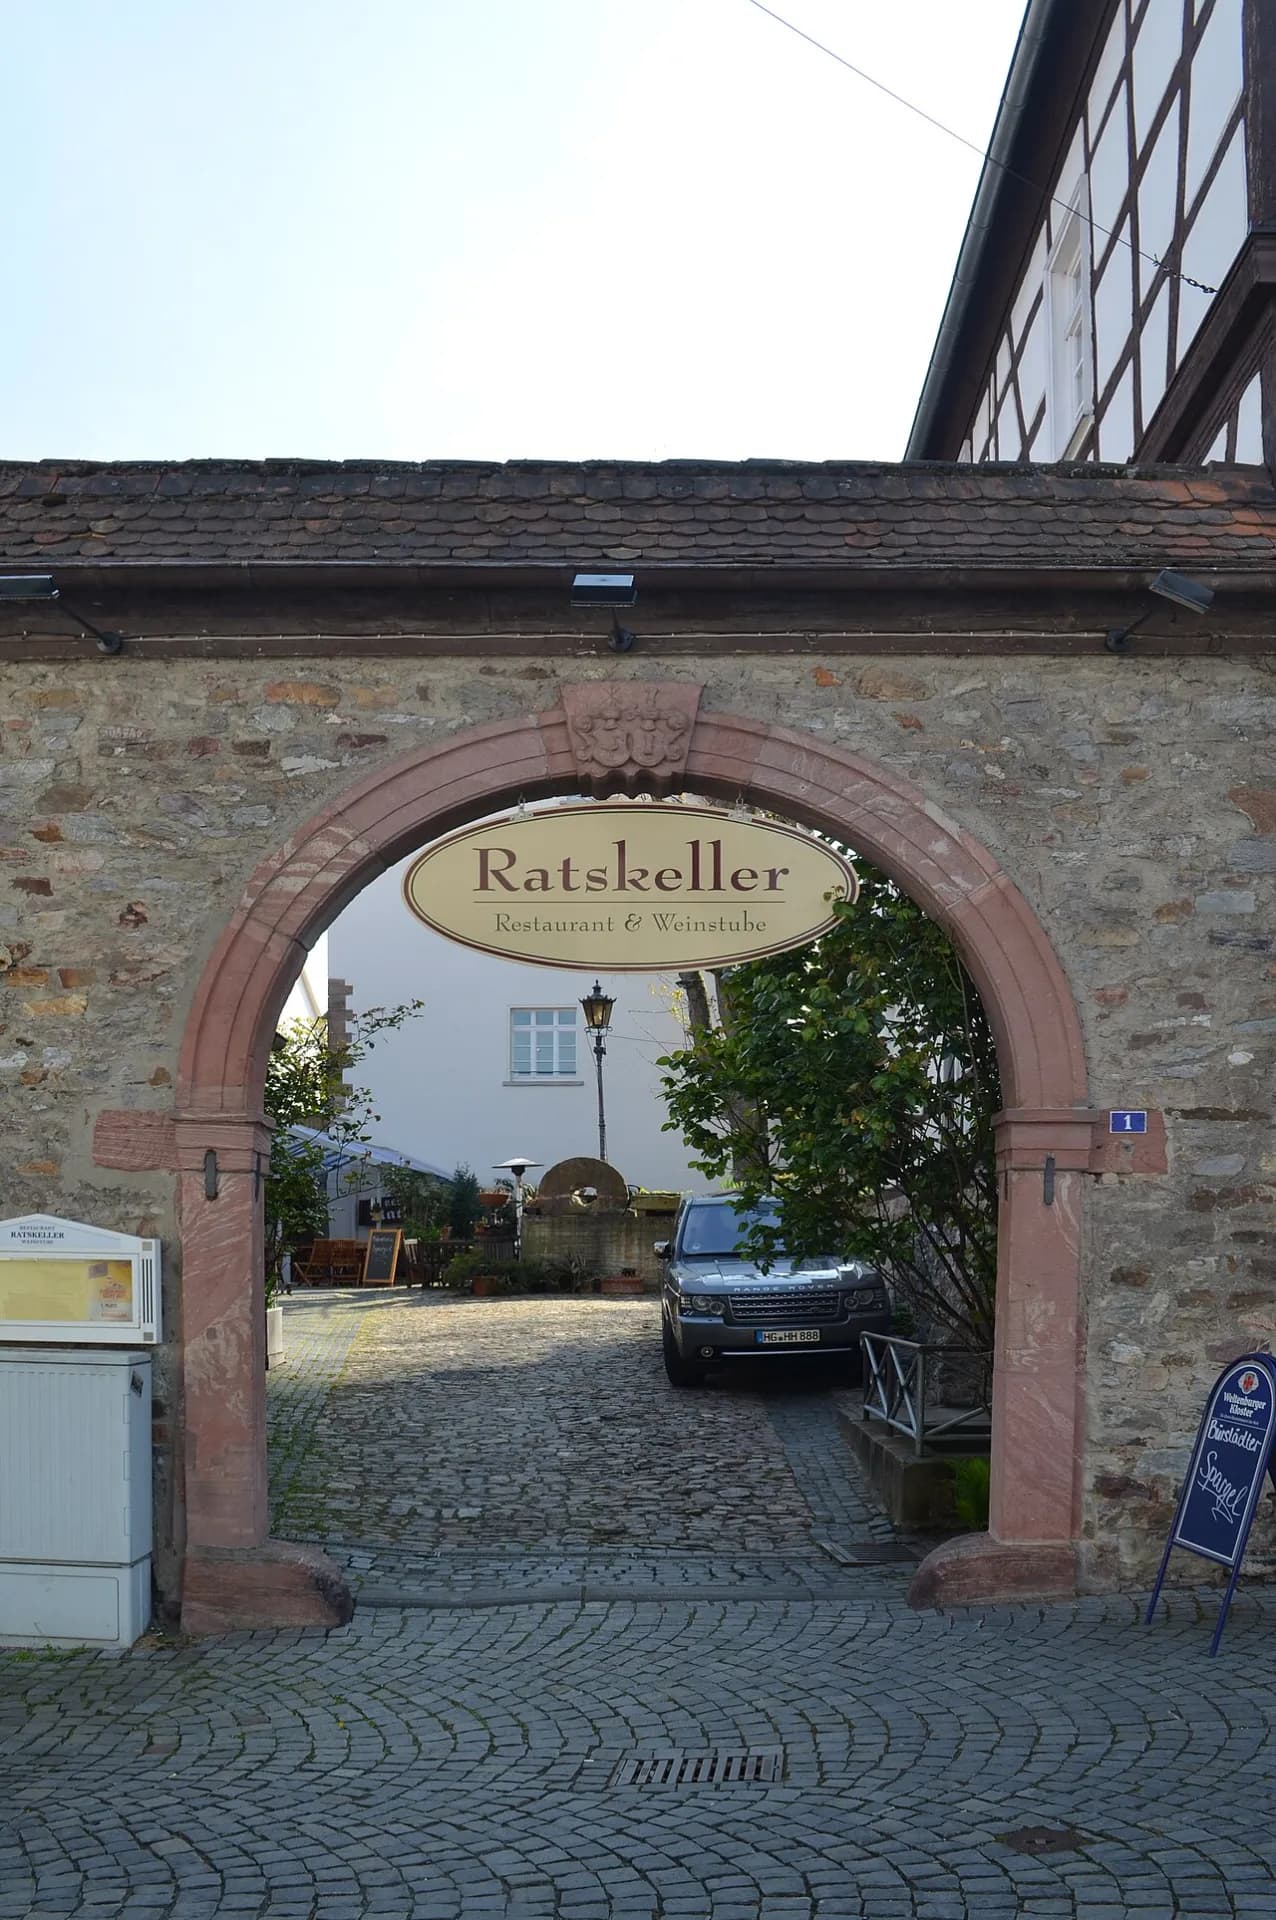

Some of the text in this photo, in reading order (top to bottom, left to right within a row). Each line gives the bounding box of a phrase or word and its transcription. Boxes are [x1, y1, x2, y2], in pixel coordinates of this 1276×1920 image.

[472, 839, 790, 893] Ratskeller
[495, 911, 767, 933] Restaurant & Weinstube
[1123, 1114, 1133, 1130] 1
[10, 1231, 65, 1239] RATSKELLER
[1229, 1403, 1254, 1418] Kloster
[1199, 1450, 1248, 1517] Spargel
